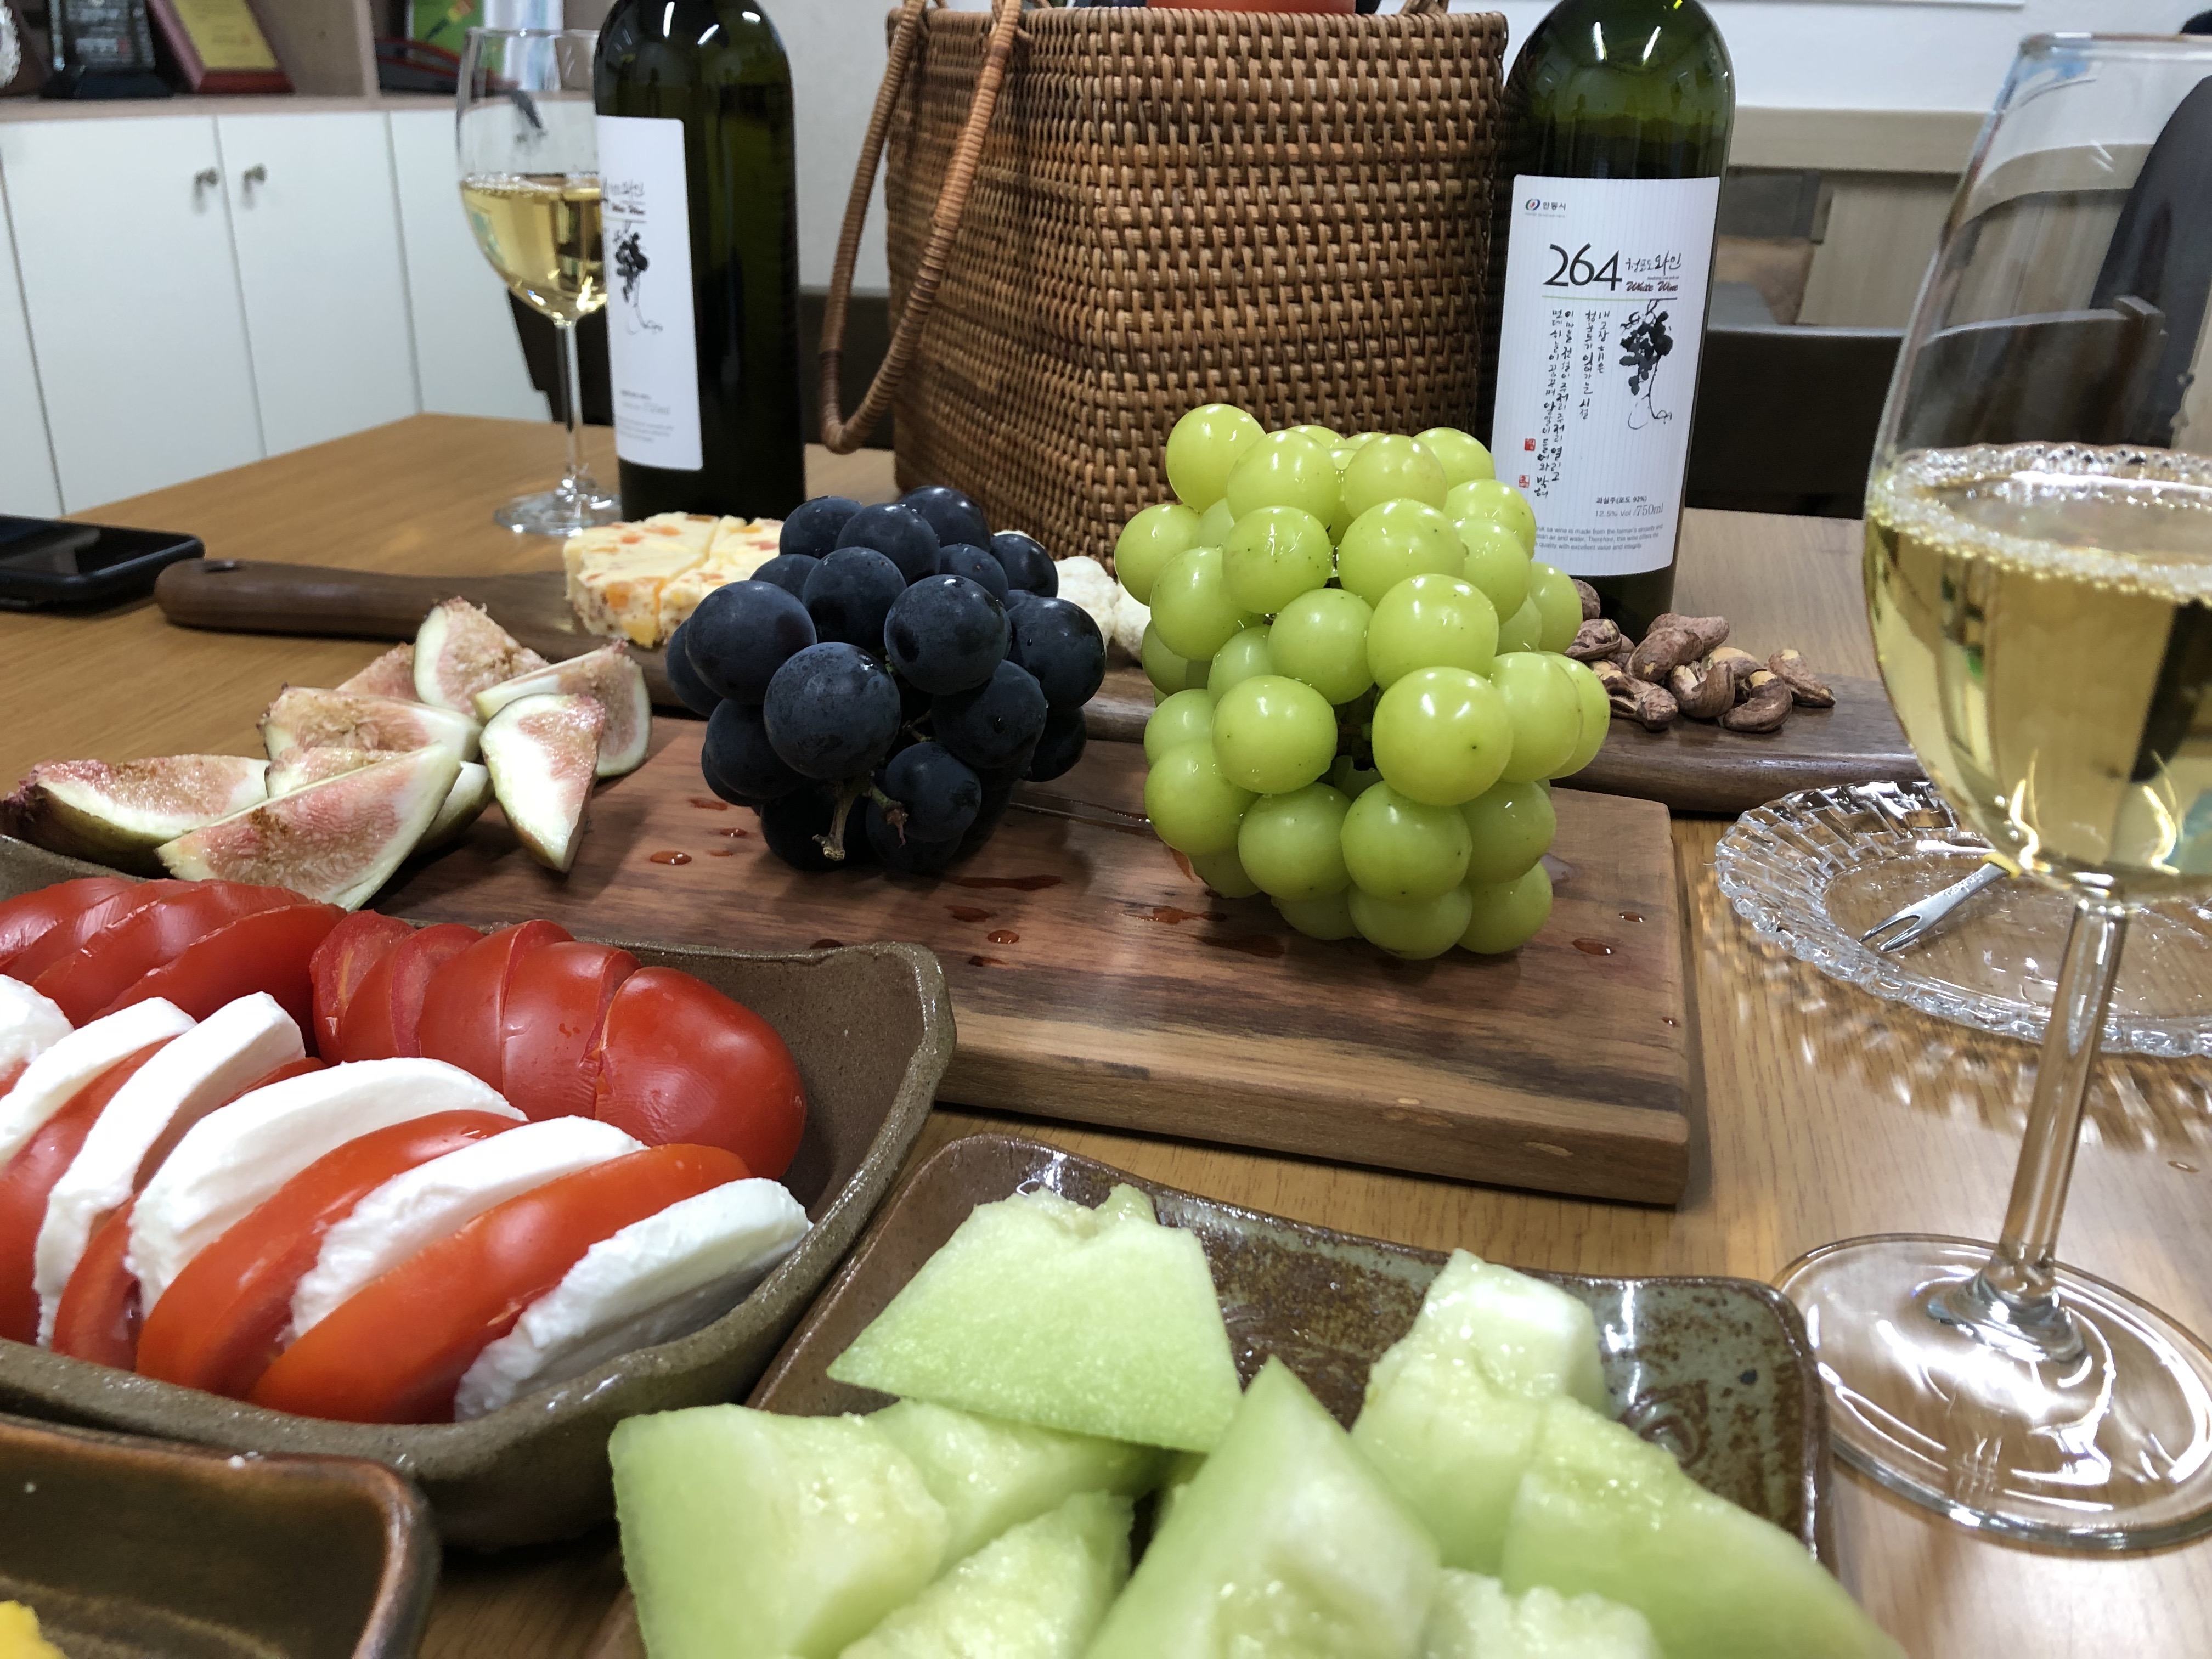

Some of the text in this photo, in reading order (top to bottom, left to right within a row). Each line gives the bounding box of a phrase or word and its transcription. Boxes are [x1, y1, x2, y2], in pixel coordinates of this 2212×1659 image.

[1542, 201, 1566, 211] 안동시
[1543, 243, 1622, 291] 264
[1626, 281, 1679, 292] White Wine
